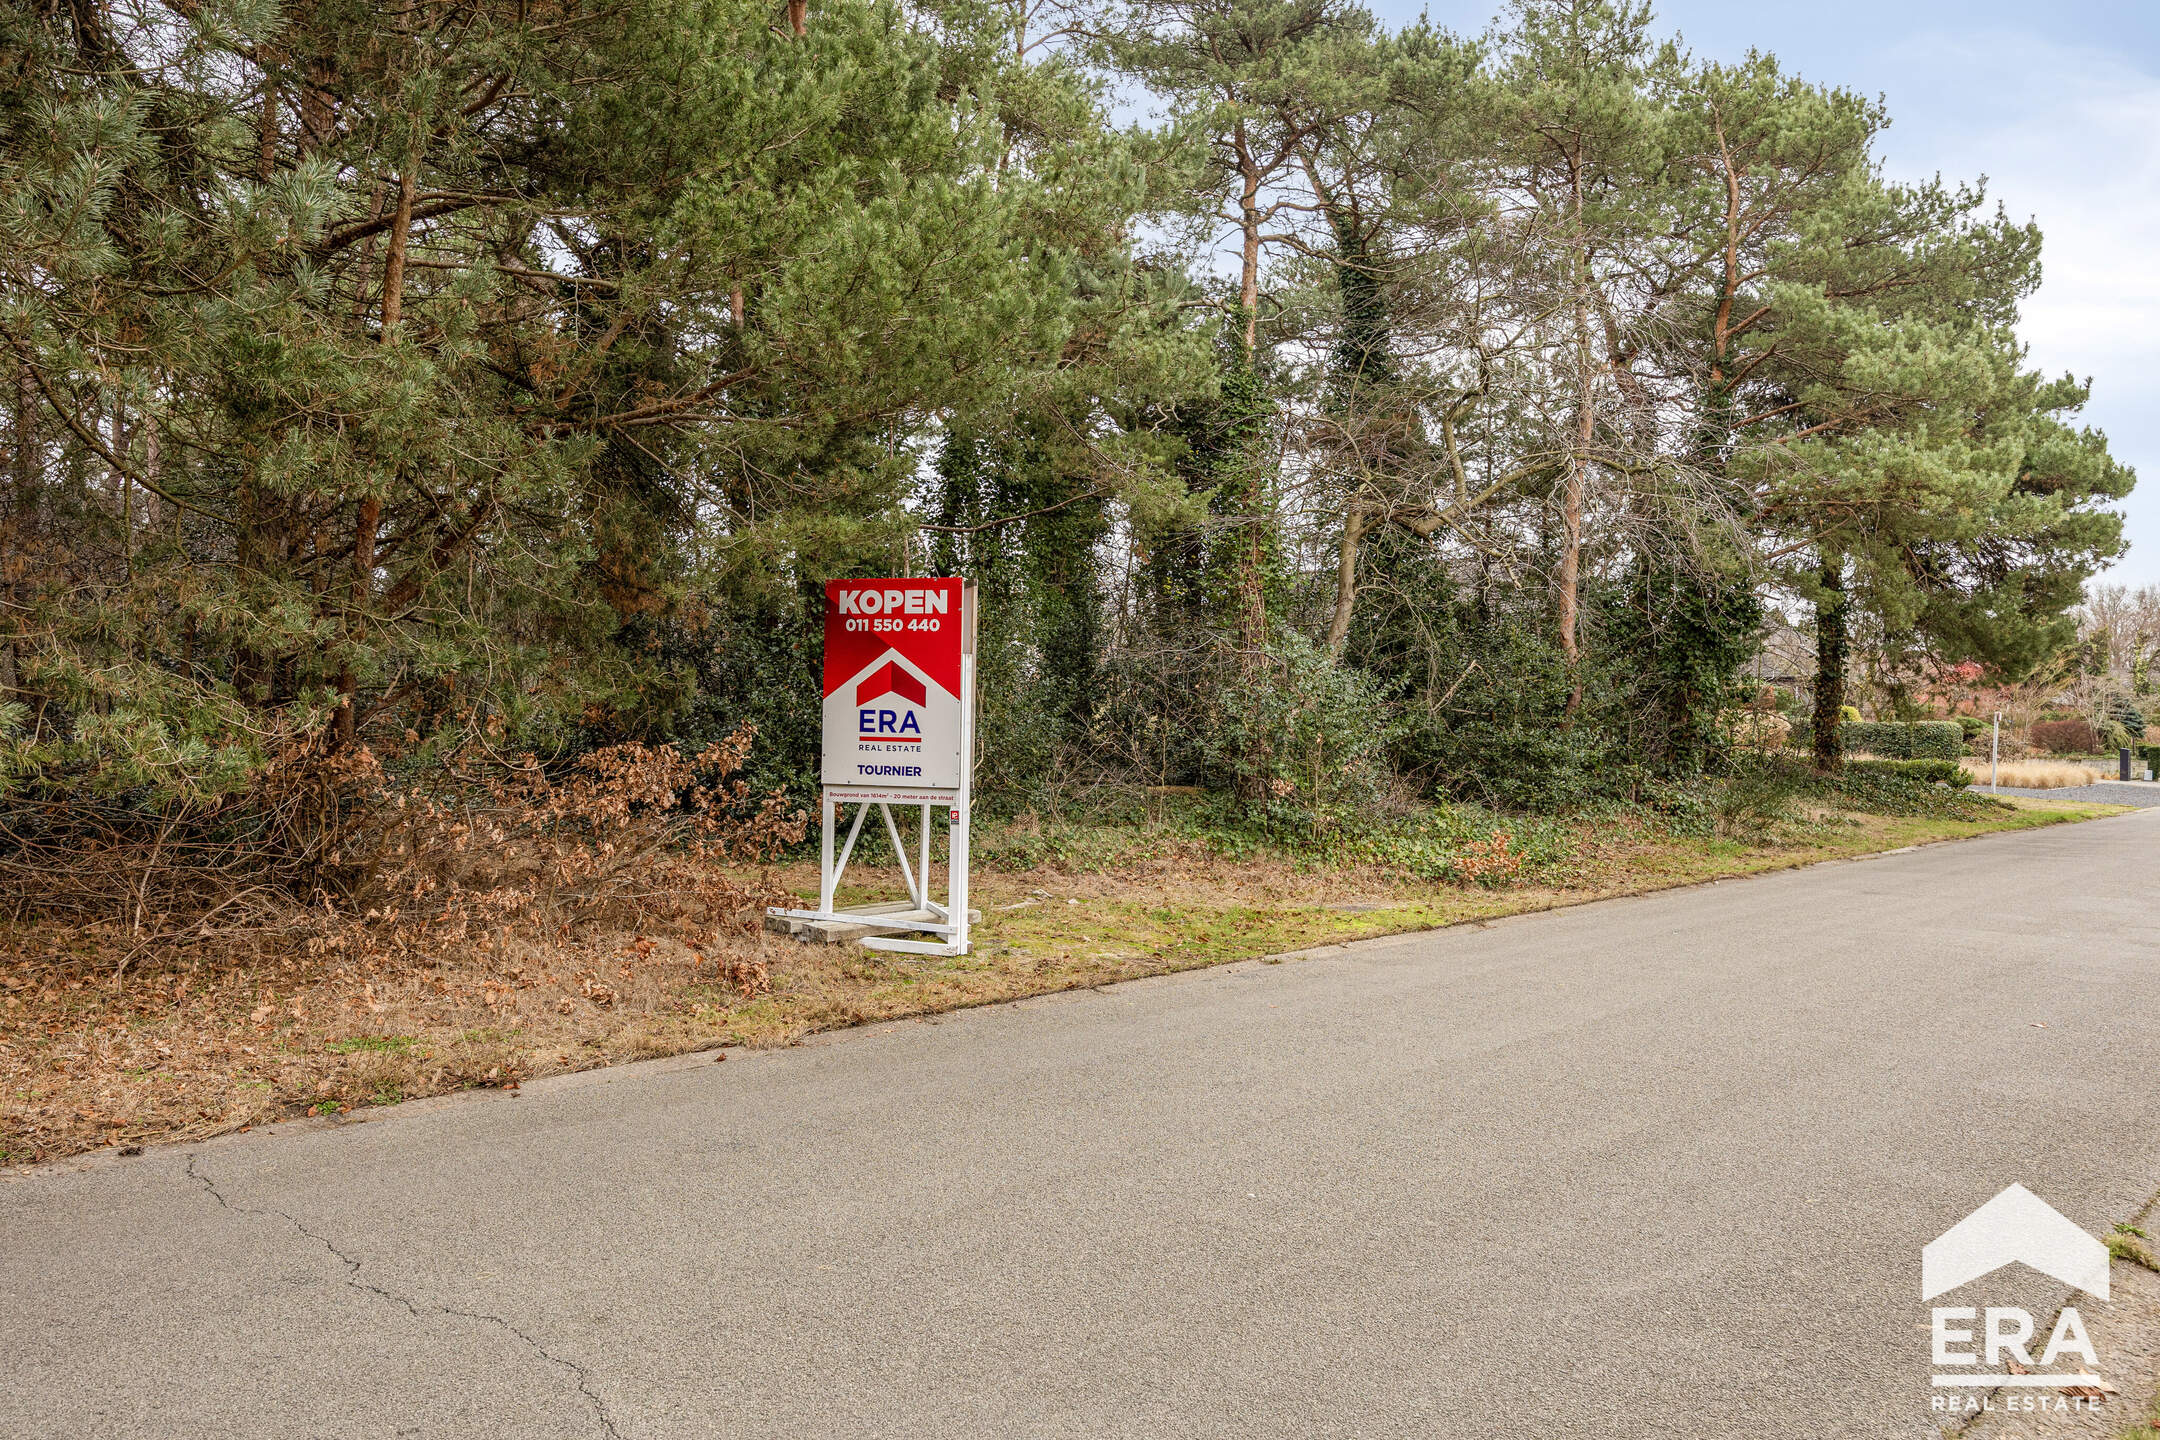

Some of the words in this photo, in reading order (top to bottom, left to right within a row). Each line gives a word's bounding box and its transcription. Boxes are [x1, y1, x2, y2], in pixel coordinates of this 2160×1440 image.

[838, 589, 948, 615] KOPEN
[845, 618, 869, 632] 011
[873, 618, 903, 632] 550
[907, 618, 940, 632] 440
[859, 709, 921, 734] ERA
[857, 764, 922, 776] TOURNIER
